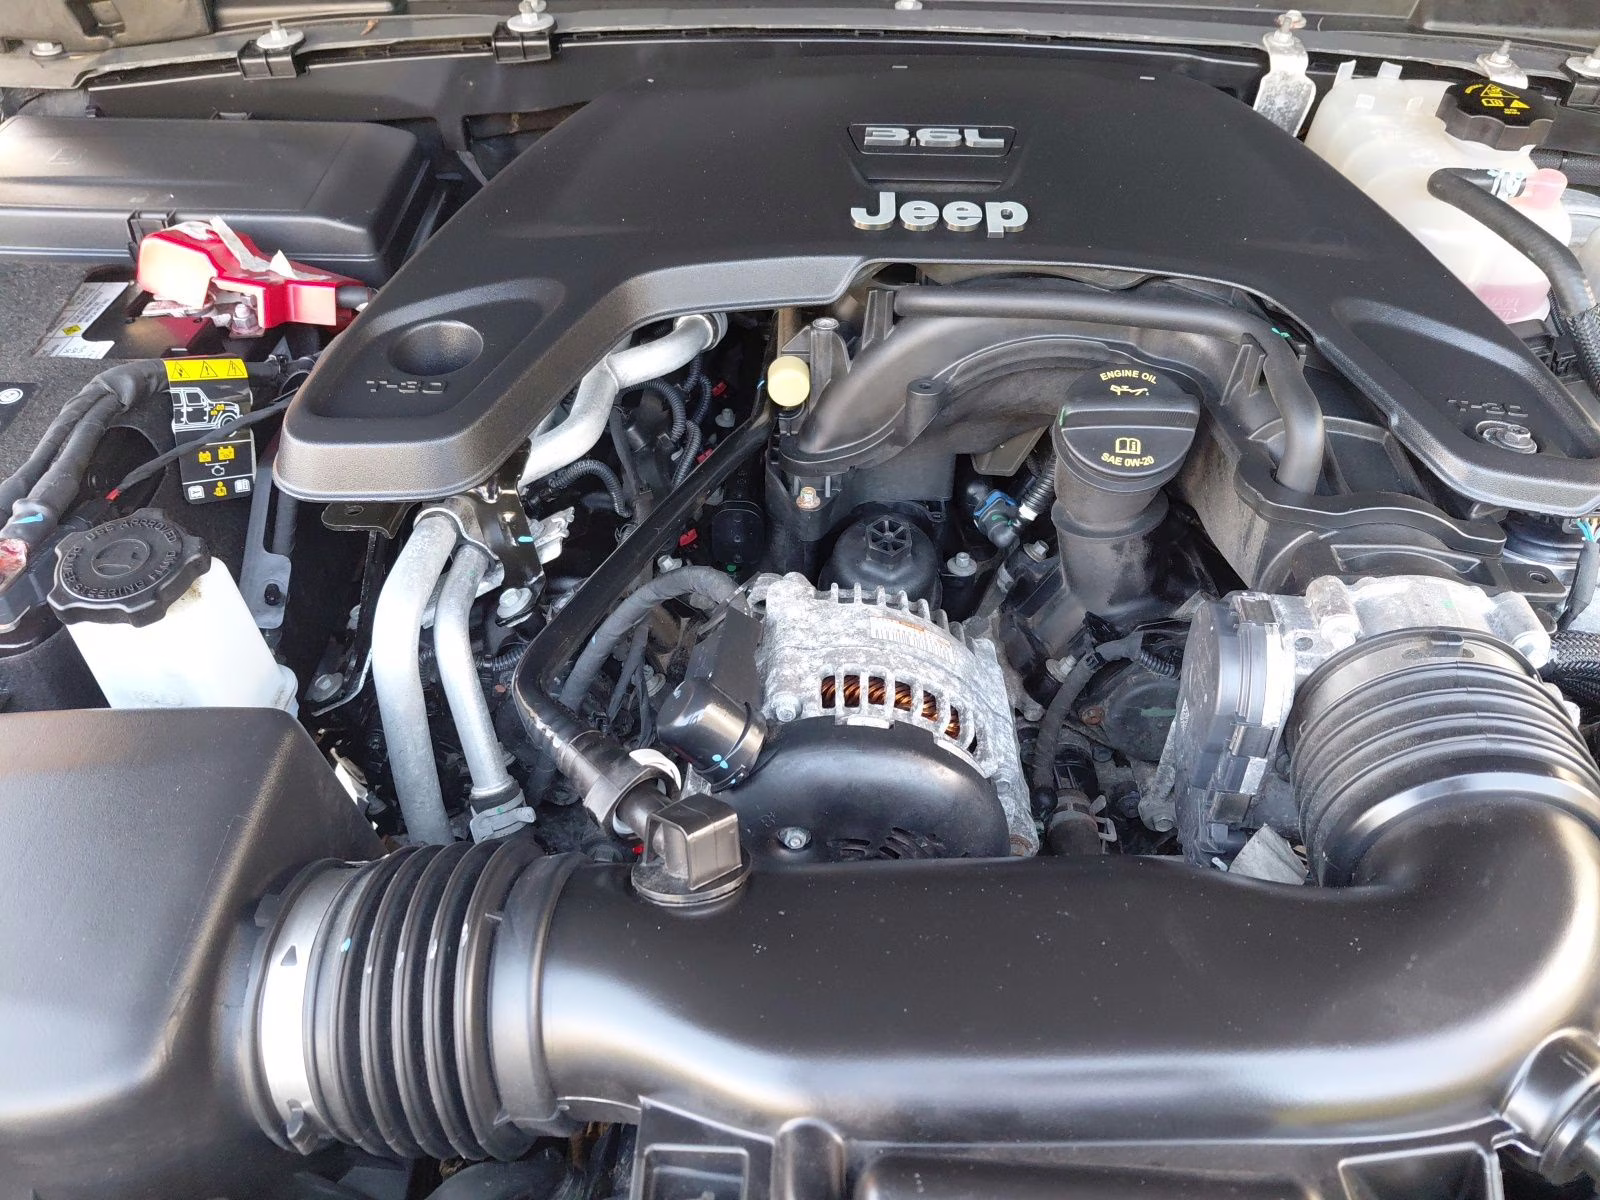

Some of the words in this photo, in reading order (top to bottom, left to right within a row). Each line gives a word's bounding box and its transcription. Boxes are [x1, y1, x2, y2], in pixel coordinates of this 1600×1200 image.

[864, 127, 1004, 147] 3.6L
[850, 191, 1029, 238] Jeep
[1100, 369, 1140, 381] ENGINE
[1141, 372, 1157, 384] OIL
[1101, 452, 1122, 466] SAE
[1124, 455, 1155, 467] 0W-20
[85, 524, 116, 542] USE
[120, 518, 178, 544] APPROVED
